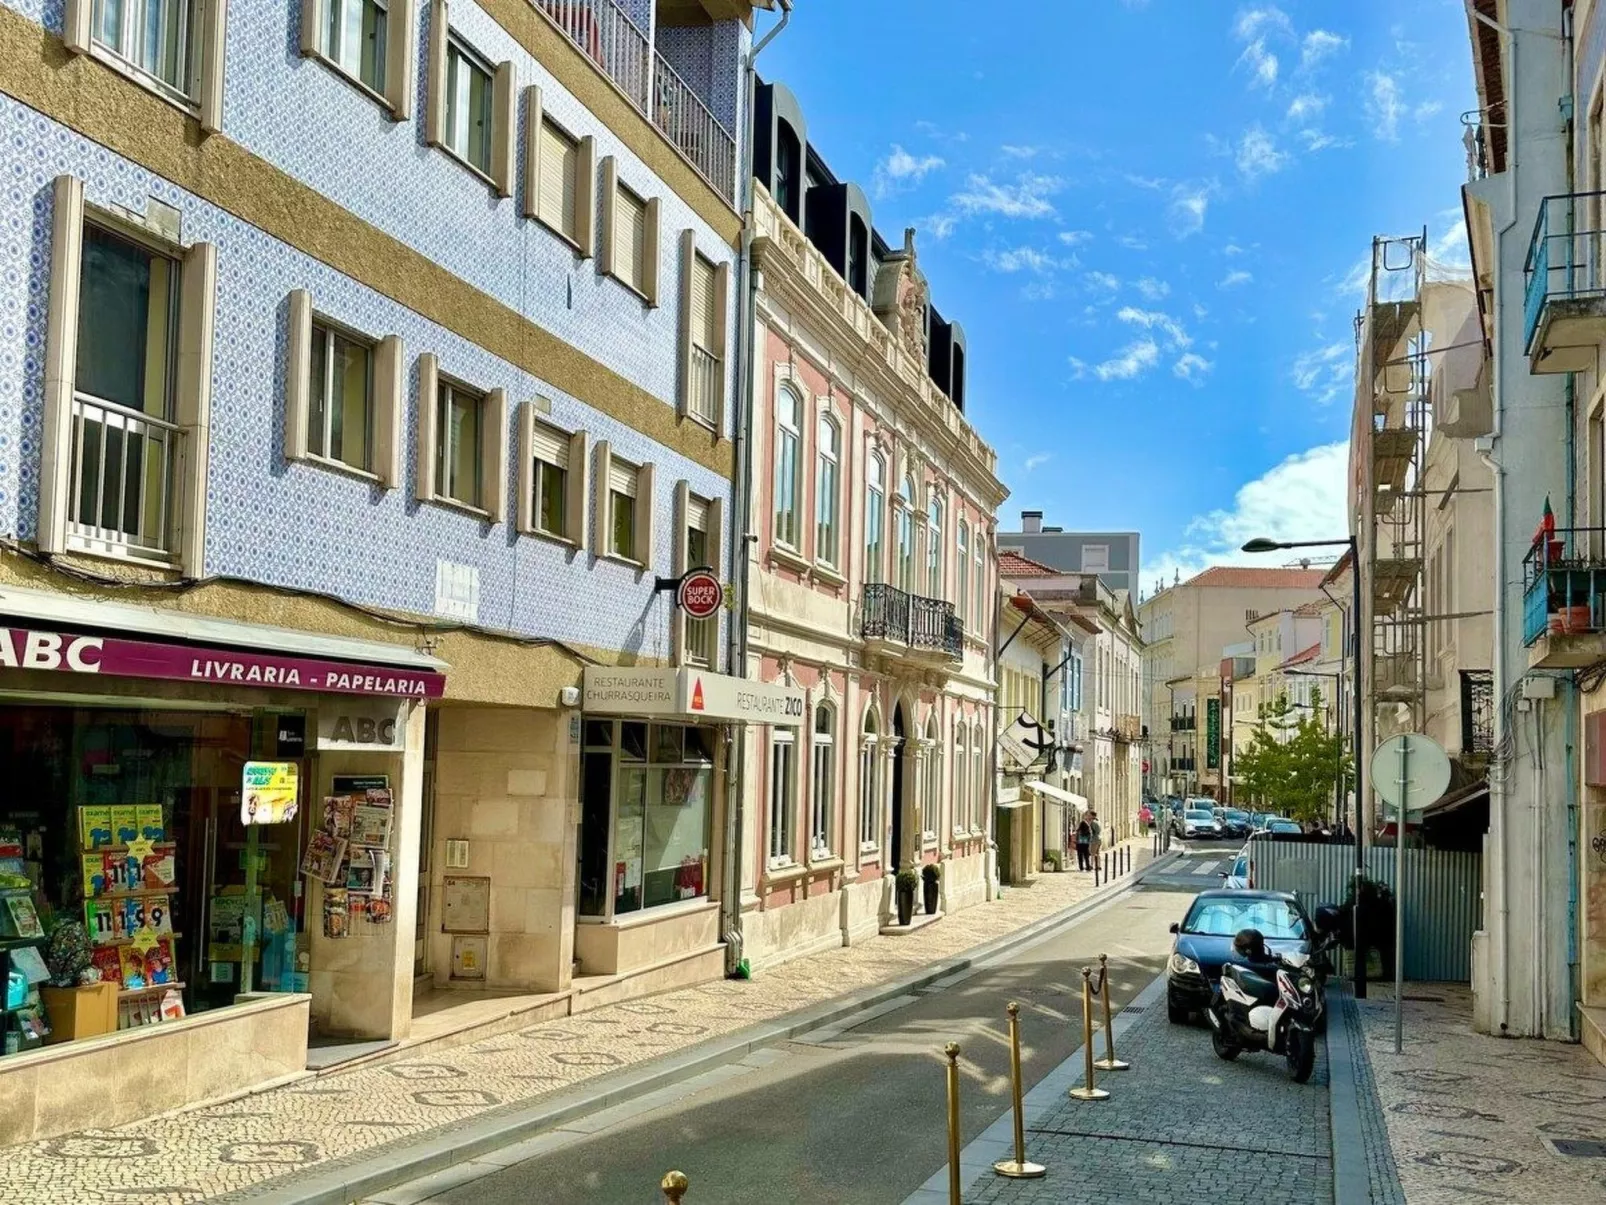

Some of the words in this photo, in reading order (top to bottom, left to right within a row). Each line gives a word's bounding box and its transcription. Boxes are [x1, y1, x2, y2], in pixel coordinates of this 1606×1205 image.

[686, 586, 716, 596] SUPER
[687, 596, 714, 605] BOCK
[191, 659, 301, 684] LIVRARIA
[325, 671, 427, 695] PAPELARIA
[593, 676, 665, 689] RESTAURANTE
[586, 690, 671, 702] CHURRASQUEIRA
[737, 691, 784, 715] RESTAURANTE
[785, 696, 803, 717] ZICO
[332, 715, 396, 744] ABC
[151, 907, 164, 927] 9
